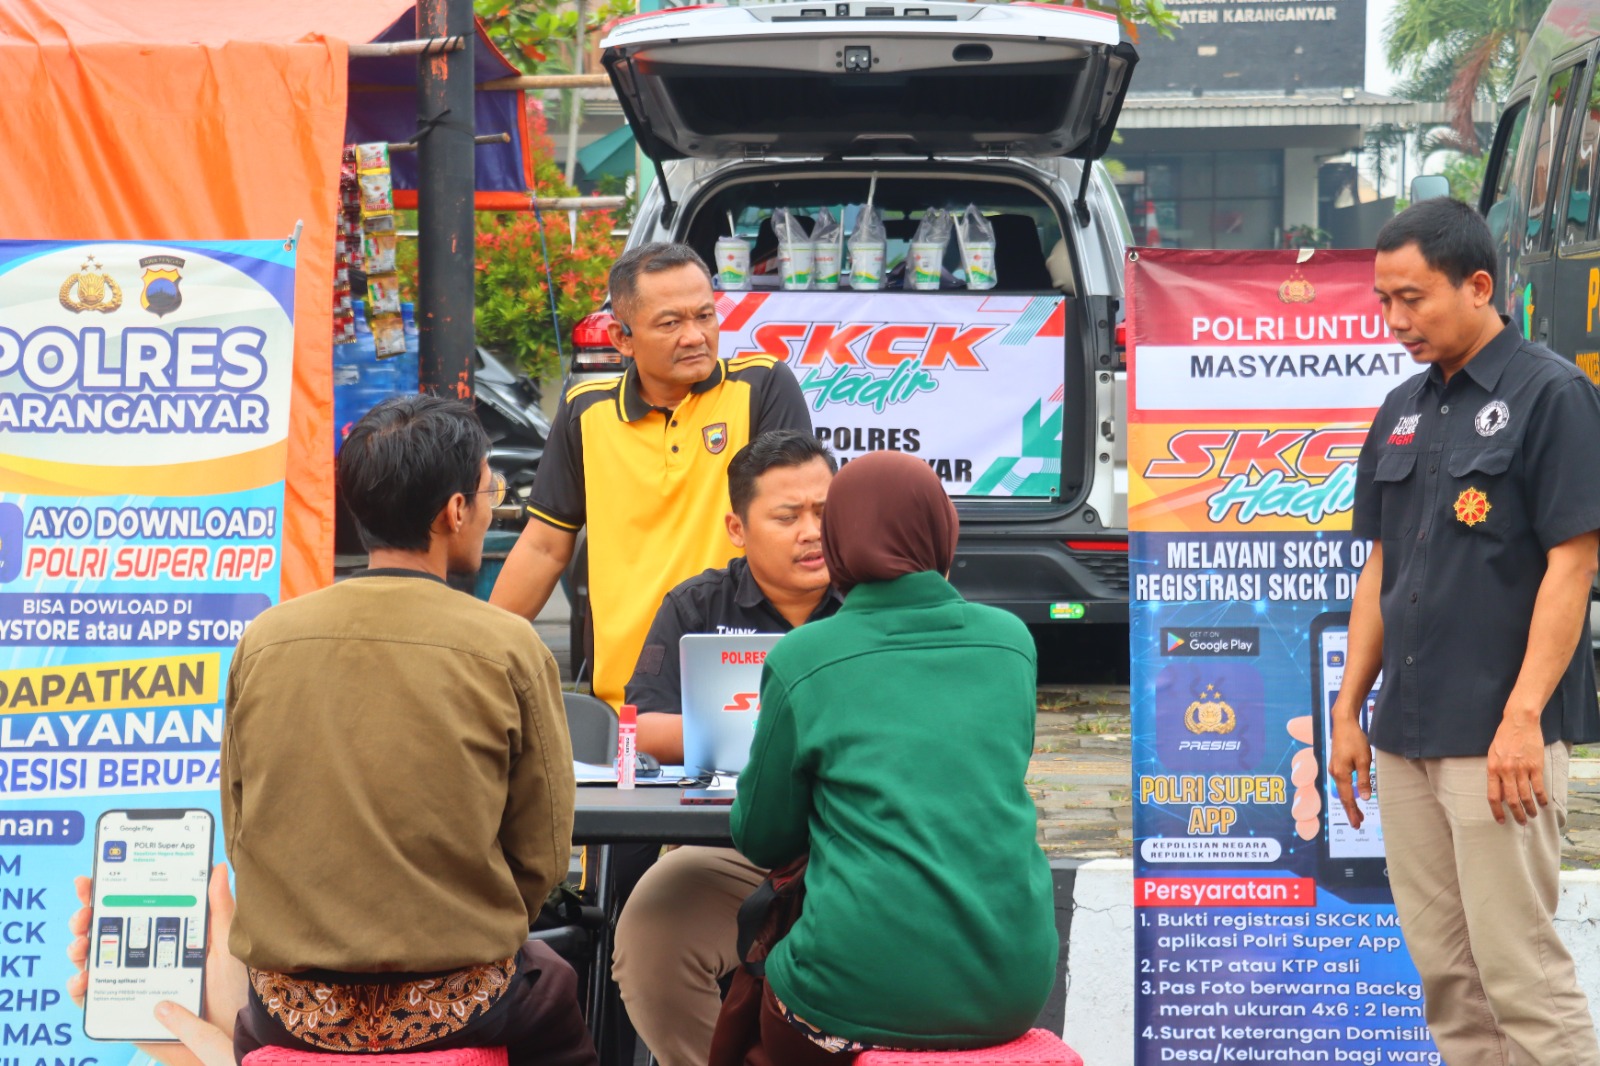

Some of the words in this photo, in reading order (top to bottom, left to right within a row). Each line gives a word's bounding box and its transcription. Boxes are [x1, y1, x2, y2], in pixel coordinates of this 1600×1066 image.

[1223, 7, 1337, 23] KARANGANYAR
[1192, 316, 1284, 341] POLRI
[736, 322, 1001, 369] SKCK
[1191, 352, 1406, 378] MASYARAKAT
[800, 359, 938, 413] Hadir
[815, 427, 920, 452] POLRES
[27, 509, 90, 537] AYO
[97, 509, 275, 537] DOWNLOAD!
[25, 547, 108, 577] POLRI
[114, 547, 208, 577] SUPER
[215, 547, 274, 577] APP
[1167, 541, 1276, 569] MELAYANI
[1283, 541, 1343, 568] SKCK
[1136, 574, 1260, 601] REGISTRASI
[1268, 574, 1328, 601] SKCK
[23, 599, 65, 615] BISA
[70, 599, 169, 615] DOWLOAD
[173, 599, 192, 614] DI
[86, 621, 132, 641] atau
[137, 619, 182, 641] APP
[716, 625, 757, 635] THINK
[721, 650, 767, 664] POLRES
[1190, 640, 1229, 653] Google
[1231, 640, 1253, 652] Play
[1, 708, 223, 748] LAYANAN
[1179, 741, 1241, 751] PRESISI
[1141, 777, 1204, 803] POLRI
[1209, 777, 1285, 803] SUPER
[1189, 807, 1236, 835] APP
[158, 842, 178, 851] Super
[180, 842, 195, 850] App
[1151, 851, 1204, 859] REPUBLIK
[1208, 851, 1270, 859] INDONESIA
[1152, 841, 1220, 849] KEPOLISIAN
[1222, 841, 1267, 849] NEGARA
[0, 887, 47, 910] NK
[1144, 881, 1288, 906] Persyaratan
[0, 920, 47, 945] CK
[1140, 913, 1151, 927] 1.
[1158, 912, 1208, 927] Bukti
[1214, 912, 1310, 931] registrasi
[1315, 913, 1371, 927] SKCK
[1158, 933, 1238, 952] aplikasi
[1243, 933, 1287, 948] Polri
[1292, 935, 1353, 952] Super
[1358, 935, 1401, 953] App
[1, 955, 41, 978] KT
[1141, 959, 1155, 973] 2.
[1159, 960, 1181, 973] Fc
[1186, 960, 1223, 973] KTP
[1228, 960, 1276, 973] atau
[1282, 959, 1318, 973] KTP
[1323, 959, 1360, 973] asli
[1141, 981, 1156, 995] 3.
[1159, 981, 1196, 995] Pas
[1201, 981, 1245, 995] Foto
[1250, 981, 1350, 995] berwarna
[1160, 1002, 1228, 1016] merah
[1235, 1002, 1306, 1016] ukuran
[1311, 1003, 1349, 1016] 4x6
[1365, 1003, 1377, 1017] 2
[1382, 1003, 1425, 1017] lem
[3, 1022, 72, 1046] MAS
[1142, 1026, 1158, 1040] 4.
[1160, 1025, 1216, 1039] Surat
[1221, 1025, 1341, 1044] keterangan
[1346, 1026, 1430, 1041] Domisili
[1161, 1043, 1329, 1064] Desa/Kelurahan
[1335, 1047, 1382, 1066] bagi
